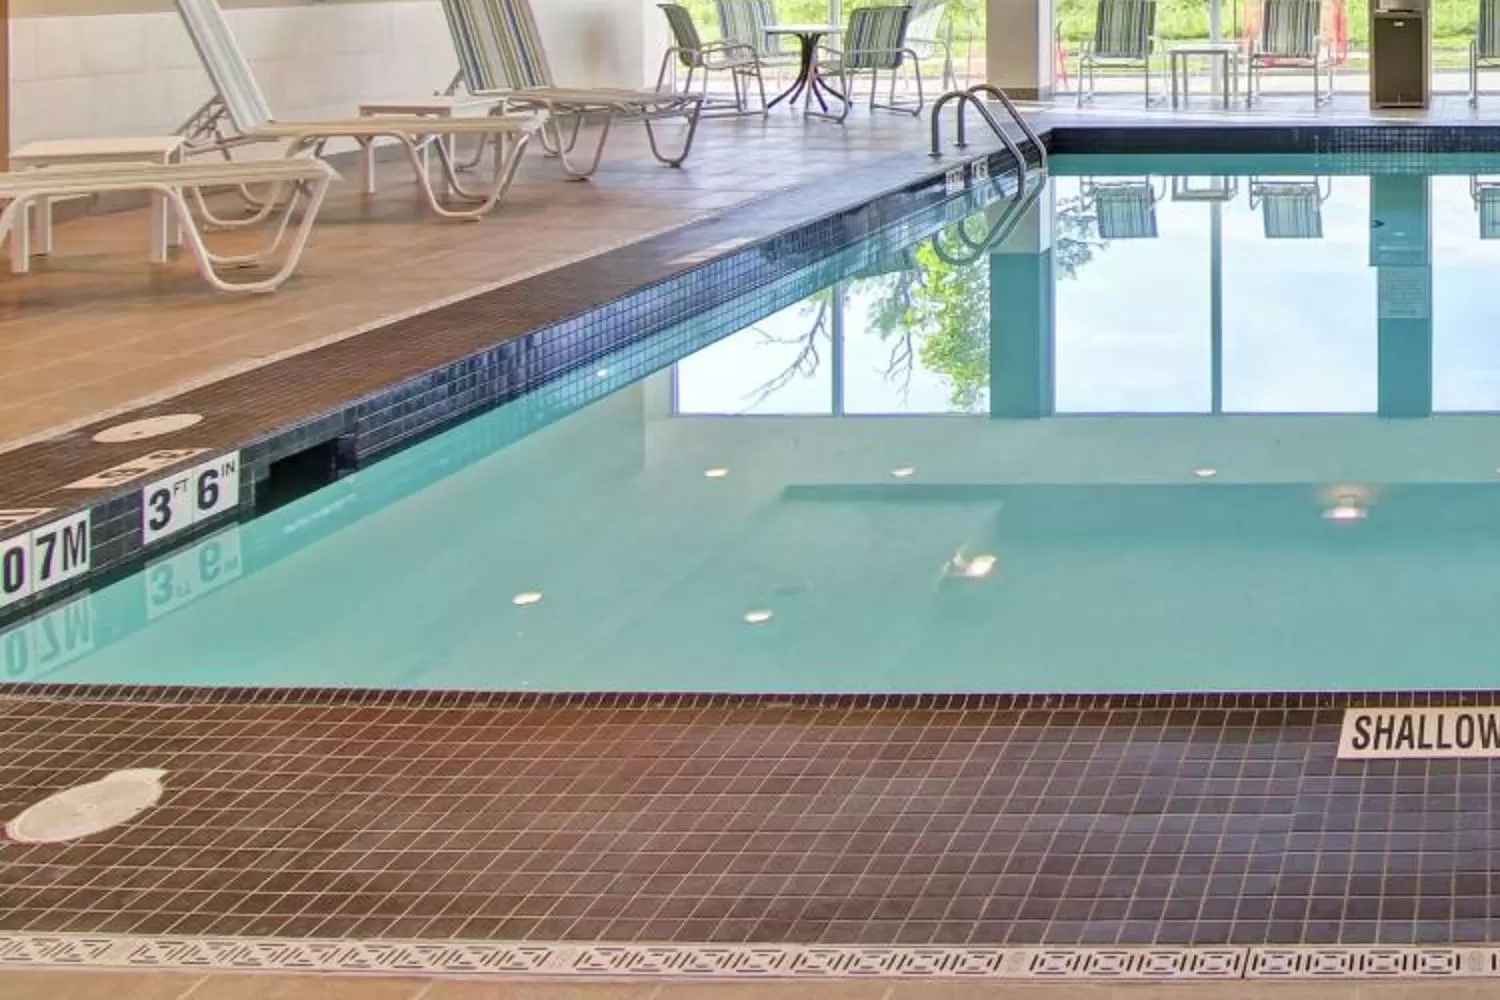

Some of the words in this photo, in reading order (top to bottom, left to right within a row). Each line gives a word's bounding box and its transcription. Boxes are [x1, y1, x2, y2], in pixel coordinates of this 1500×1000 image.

[149, 487, 172, 532] 3
[173, 478, 189, 497] FT
[197, 468, 219, 510] 6
[221, 460, 236, 477] IN
